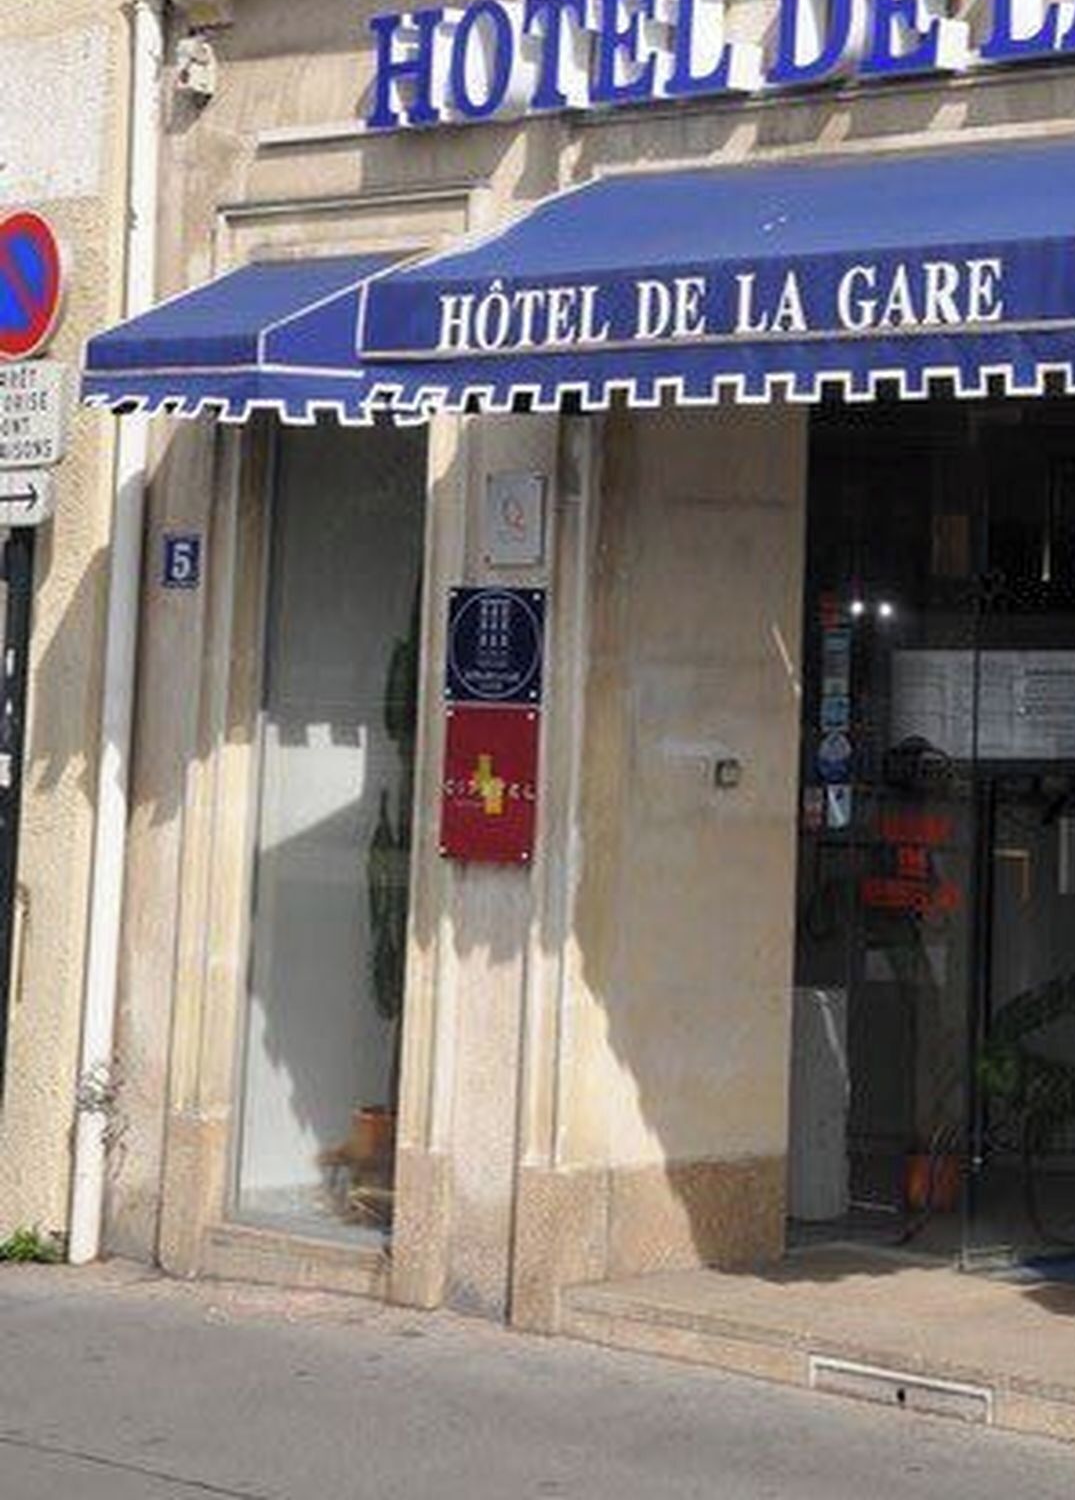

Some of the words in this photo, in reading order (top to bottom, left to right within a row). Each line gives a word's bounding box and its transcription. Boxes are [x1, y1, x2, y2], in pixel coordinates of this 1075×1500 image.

[435, 279, 610, 352] HÔTEL
[633, 275, 708, 340] DE
[734, 270, 808, 334] LA
[837, 258, 1003, 330] GARE
[171, 542, 192, 580] 5
